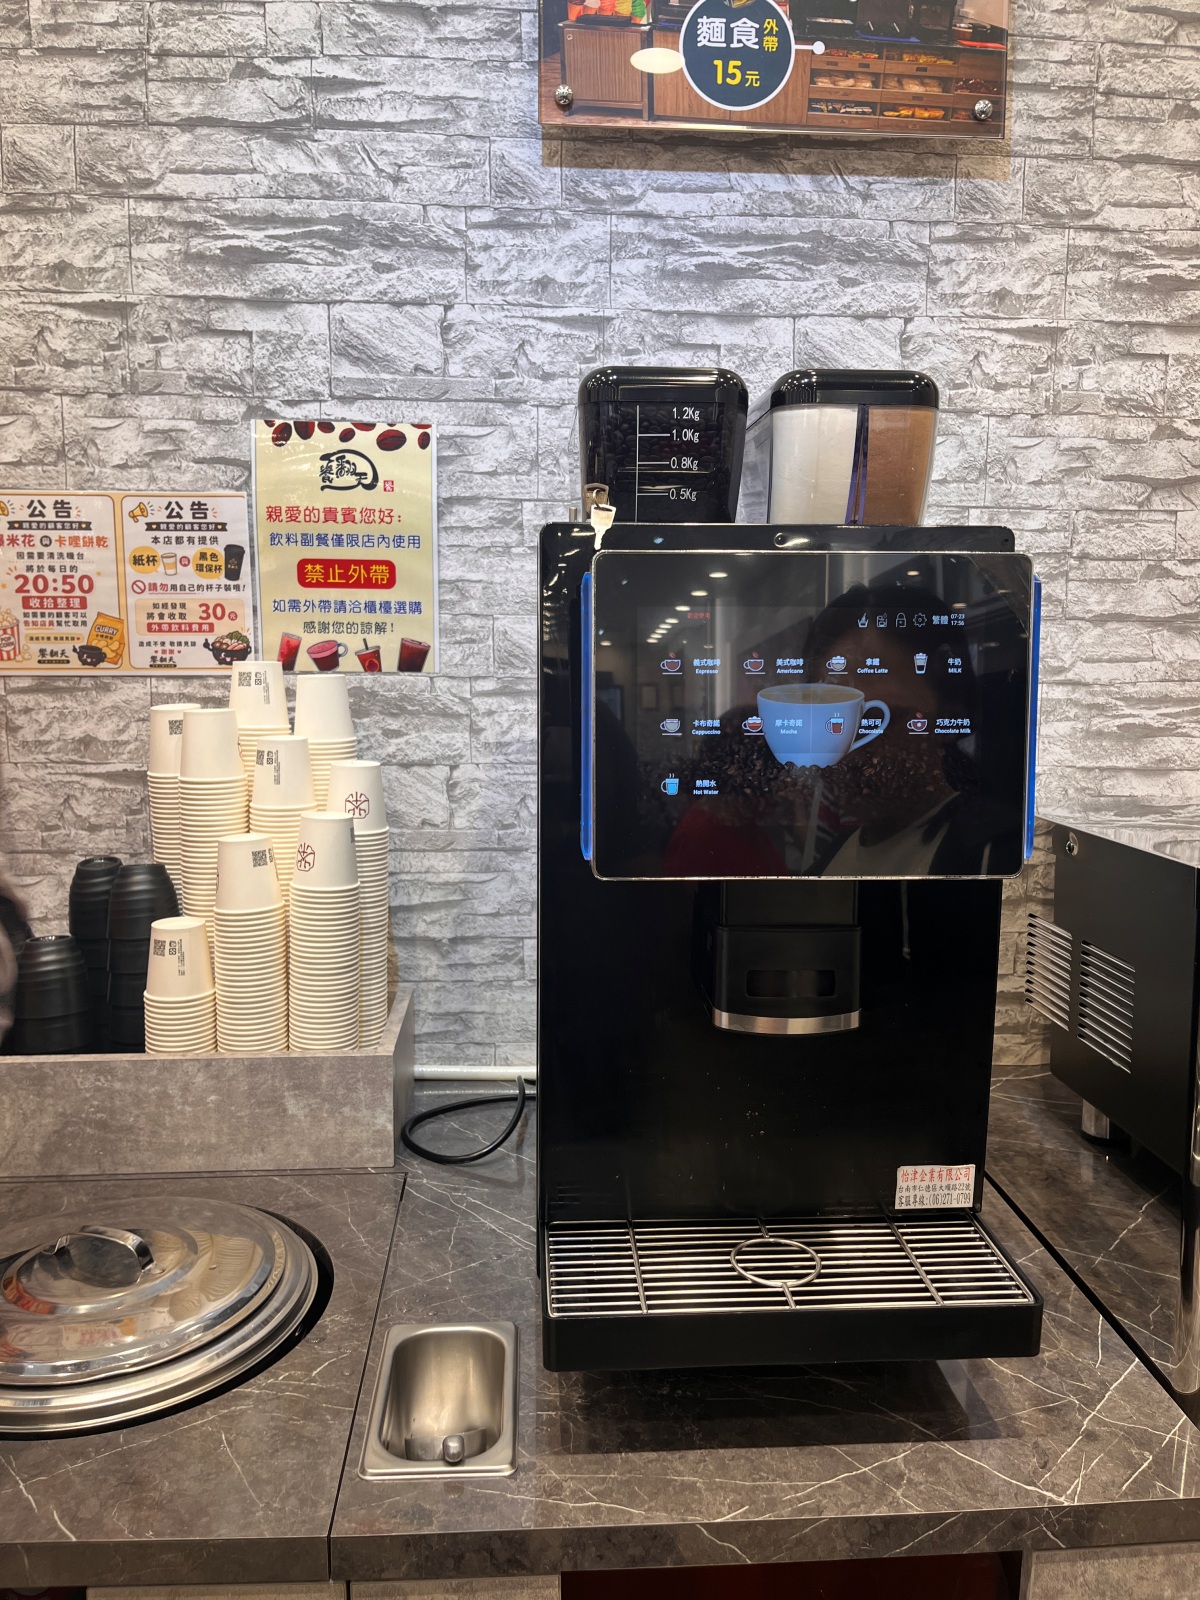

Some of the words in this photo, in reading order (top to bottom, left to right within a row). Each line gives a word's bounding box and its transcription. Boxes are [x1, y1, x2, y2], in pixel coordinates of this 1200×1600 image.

[696, 16, 760, 49] 麵食
[763, 18, 779, 52] 外帶
[713, 60, 742, 86] 15
[745, 69, 760, 88] 元
[672, 407, 700, 421] 1.2Kg
[672, 429, 700, 443] 1.0Kg
[670, 457, 699, 471] 0.8Kg
[669, 488, 697, 502] 0.5Kg
[26, 499, 73, 519] 公告
[164, 500, 209, 520] 公告
[22, 522, 80, 530] 親愛的顧客您好
[159, 523, 216, 531] 親愛的顧客您好
[151, 536, 219, 546] 本店都有提供
[269, 532, 421, 549] 飲料副餐僅限店內使用
[132, 554, 158, 567] 紙杯
[198, 552, 219, 562] 黑色
[25, 564, 79, 573] 將於每日的
[195, 563, 223, 574] 環保杯
[304, 563, 390, 585] 禁止外帶
[14, 574, 94, 594] 20:50
[29, 597, 82, 609] 收拾整理
[152, 602, 187, 610] 如經發現
[146, 612, 187, 621] 將會收取
[198, 603, 226, 621] 30
[229, 612, 237, 620] 元
[94, 625, 119, 636] CURRY
[151, 623, 210, 632] 外帶飲料費用
[302, 620, 395, 635] 感謝您的諒解!
[776, 658, 804, 667] 美式咖啡
[947, 658, 962, 666] 牛奶
[692, 719, 721, 728] 卡布奇諾
[861, 718, 883, 727] 熱可可
[935, 718, 971, 727] 巧克力牛奶
[901, 1167, 971, 1183] 怡津企業有限公司
